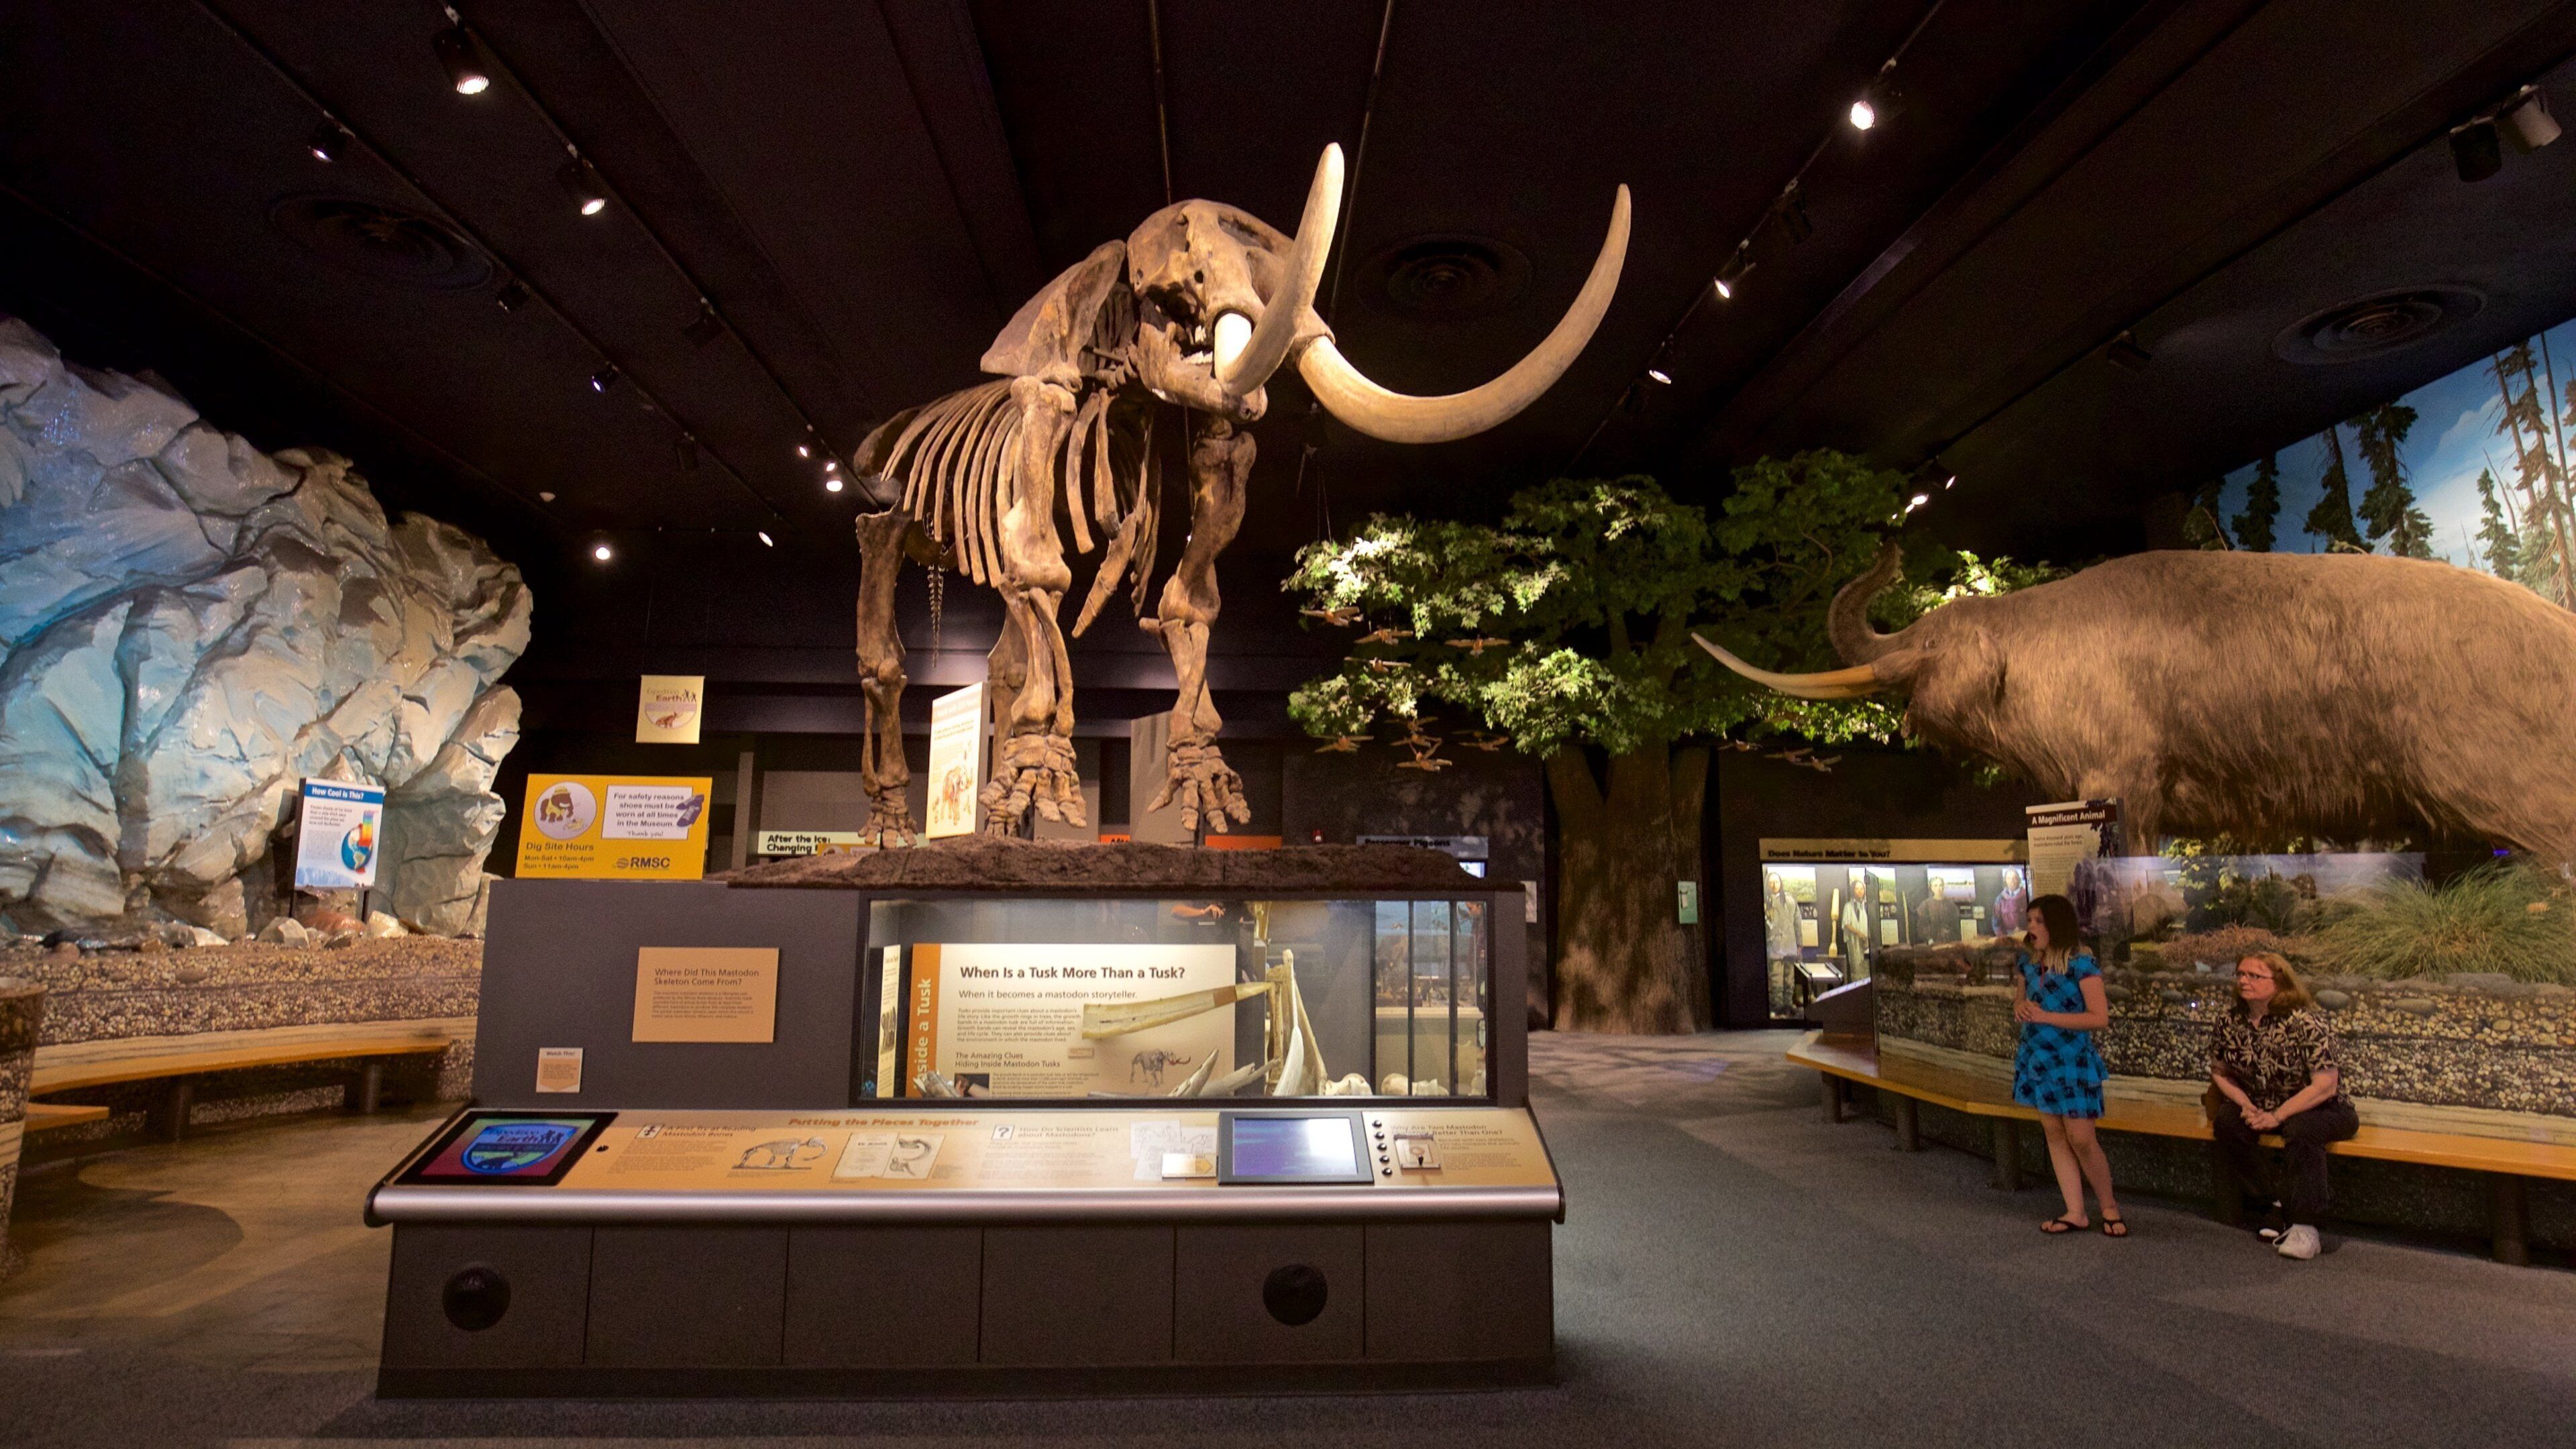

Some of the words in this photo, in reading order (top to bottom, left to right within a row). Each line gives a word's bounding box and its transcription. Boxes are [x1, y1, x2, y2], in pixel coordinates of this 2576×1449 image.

[311, 786, 327, 796] How
[327, 788, 341, 798] Cool
[343, 790, 348, 798] Is
[350, 790, 364, 800] This?
[629, 793, 651, 801] safety
[2031, 816, 2037, 825] A
[2038, 813, 2078, 826] Magnificent
[2080, 809, 2105, 820] Animal
[767, 835, 793, 843] After
[796, 835, 812, 843] the
[526, 842, 542, 851] Dig
[545, 842, 564, 851] Site
[566, 843, 594, 851] Hours
[767, 844, 812, 853] Changing
[631, 857, 671, 868] RMSC
[655, 969, 680, 977] Where
[684, 969, 698, 977] Did
[700, 969, 716, 977] This
[718, 969, 759, 977] Mastodon
[960, 966, 999, 979] When
[1004, 967, 1013, 979] Is
[1017, 969, 1025, 979] a
[1029, 966, 1057, 979] Tusk
[1063, 967, 1097, 979] More
[1101, 966, 1133, 979] Than
[1138, 969, 1146, 979] a
[1148, 967, 1185, 979] Tusk?
[654, 978, 690, 986] Skeleton
[692, 978, 715, 986] Come
[716, 978, 742, 986] From?
[917, 978, 931, 1016] Tusk
[959, 990, 985, 999] When
[987, 990, 994, 999] it
[997, 990, 1035, 999] becomes
[1045, 990, 1089, 999] mastodon
[1091, 990, 1138, 1001] storyteller.
[971, 1052, 1003, 1061] Amazing
[914, 1037, 928, 1088] side
[955, 1061, 979, 1069] Hiding
[788, 1118, 841, 1127] Putting
[845, 1118, 868, 1126] the
[872, 1118, 914, 1126] Pieces
[918, 1118, 979, 1127] Together
